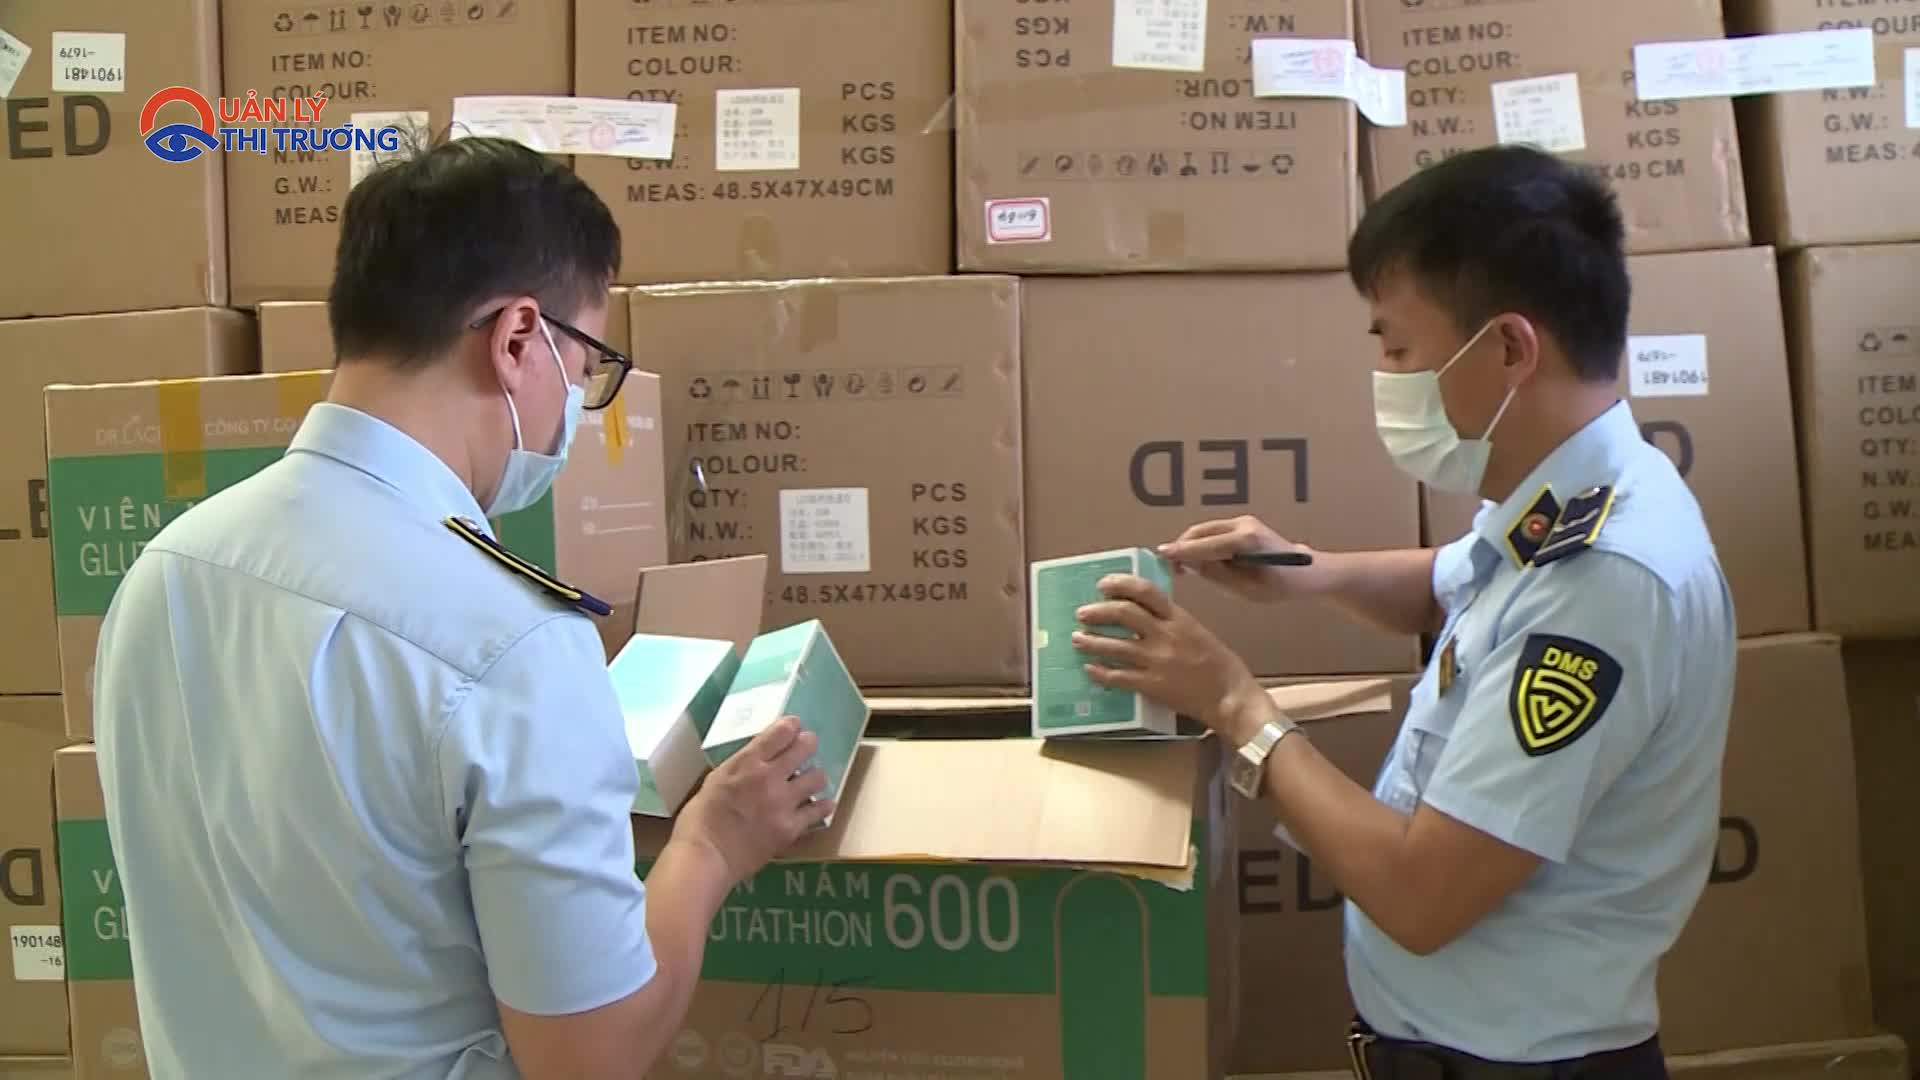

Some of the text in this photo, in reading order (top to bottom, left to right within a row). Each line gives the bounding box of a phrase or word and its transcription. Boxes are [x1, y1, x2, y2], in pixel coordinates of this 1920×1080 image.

[627, 23, 737, 45] ITEM NO:
[1015, 16, 1069, 35] KGS
[1402, 21, 1513, 47] ITEM NO:
[59, 47, 97, 58] -1679
[272, 51, 373, 73] ITEM NO:
[1015, 49, 1071, 68] PCS
[627, 55, 743, 77] COLOUR:
[1405, 50, 1522, 77] COLOUR:
[65, 67, 123, 82] 1901481
[841, 82, 896, 101] PCS
[1409, 87, 1466, 107] QTY:
[842, 113, 897, 134] KGS
[1181, 110, 1296, 130] ITEM NO:
[1412, 116, 1476, 137] N.W.:
[1824, 112, 1889, 132] G.W.:
[1626, 128, 1681, 149] KGS
[842, 145, 896, 166] KGS
[274, 176, 333, 195] G.W.:
[627, 177, 895, 204] MEAS: 48.5X47X49CM
[1857, 374, 1917, 394] ITEM
[687, 420, 801, 443] ITEM NO:
[688, 453, 808, 476] COLOUR:
[1129, 437, 1310, 508] LED
[688, 488, 747, 509] QTY:
[911, 482, 967, 503] PCS
[78, 495, 161, 532] VIÊN
[689, 521, 752, 541] N.W.:
[913, 515, 969, 537] KGS
[913, 548, 968, 569] KGS
[780, 581, 968, 605] 48.5X47X49CM
[1542, 646, 1599, 681] DMS
[882, 873, 1021, 952] 600
